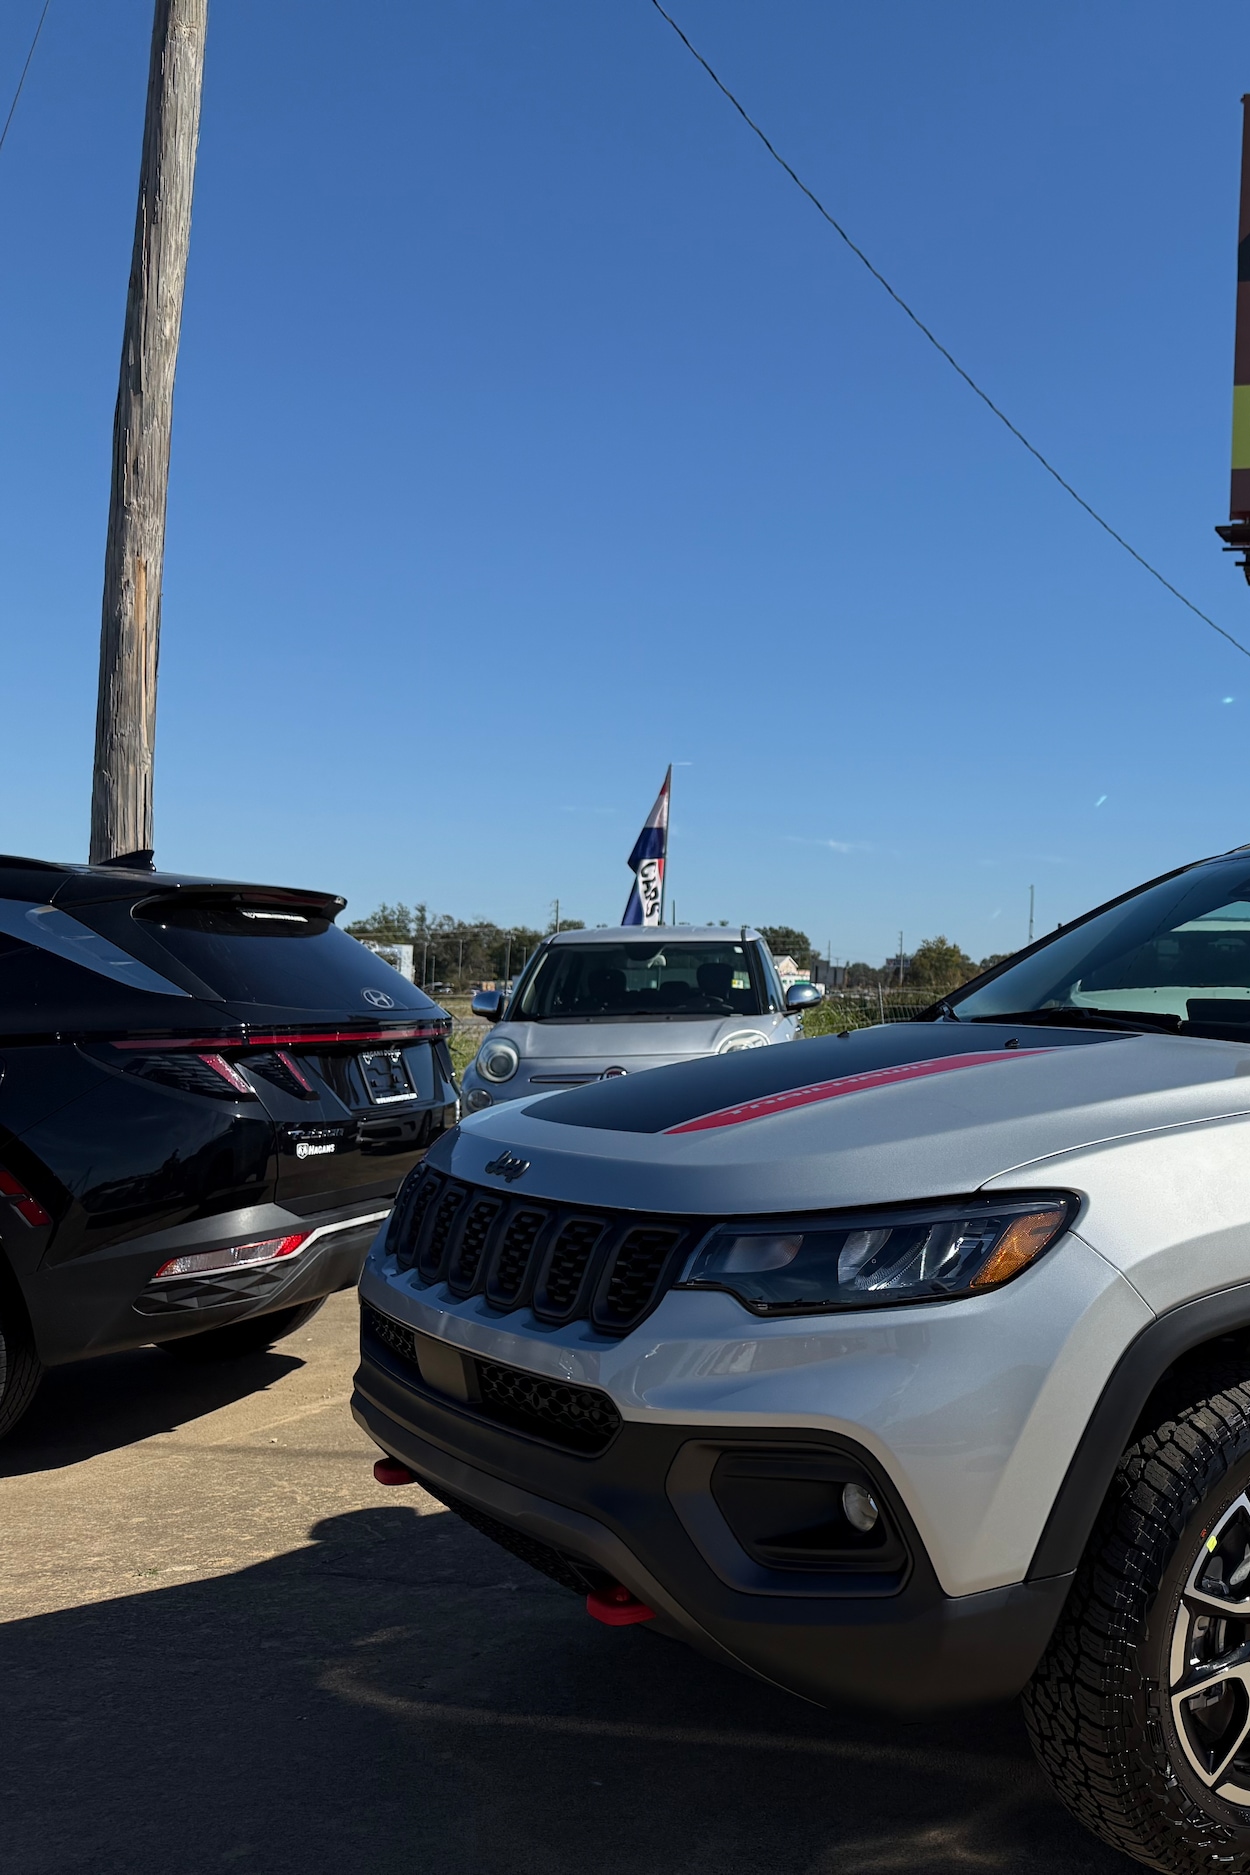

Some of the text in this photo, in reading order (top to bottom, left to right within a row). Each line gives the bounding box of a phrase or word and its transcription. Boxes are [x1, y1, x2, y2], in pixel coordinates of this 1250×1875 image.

[641, 862, 659, 917] CARS
[719, 1061, 936, 1116] TRAILHAWK
[485, 1151, 531, 1183] Jeep
